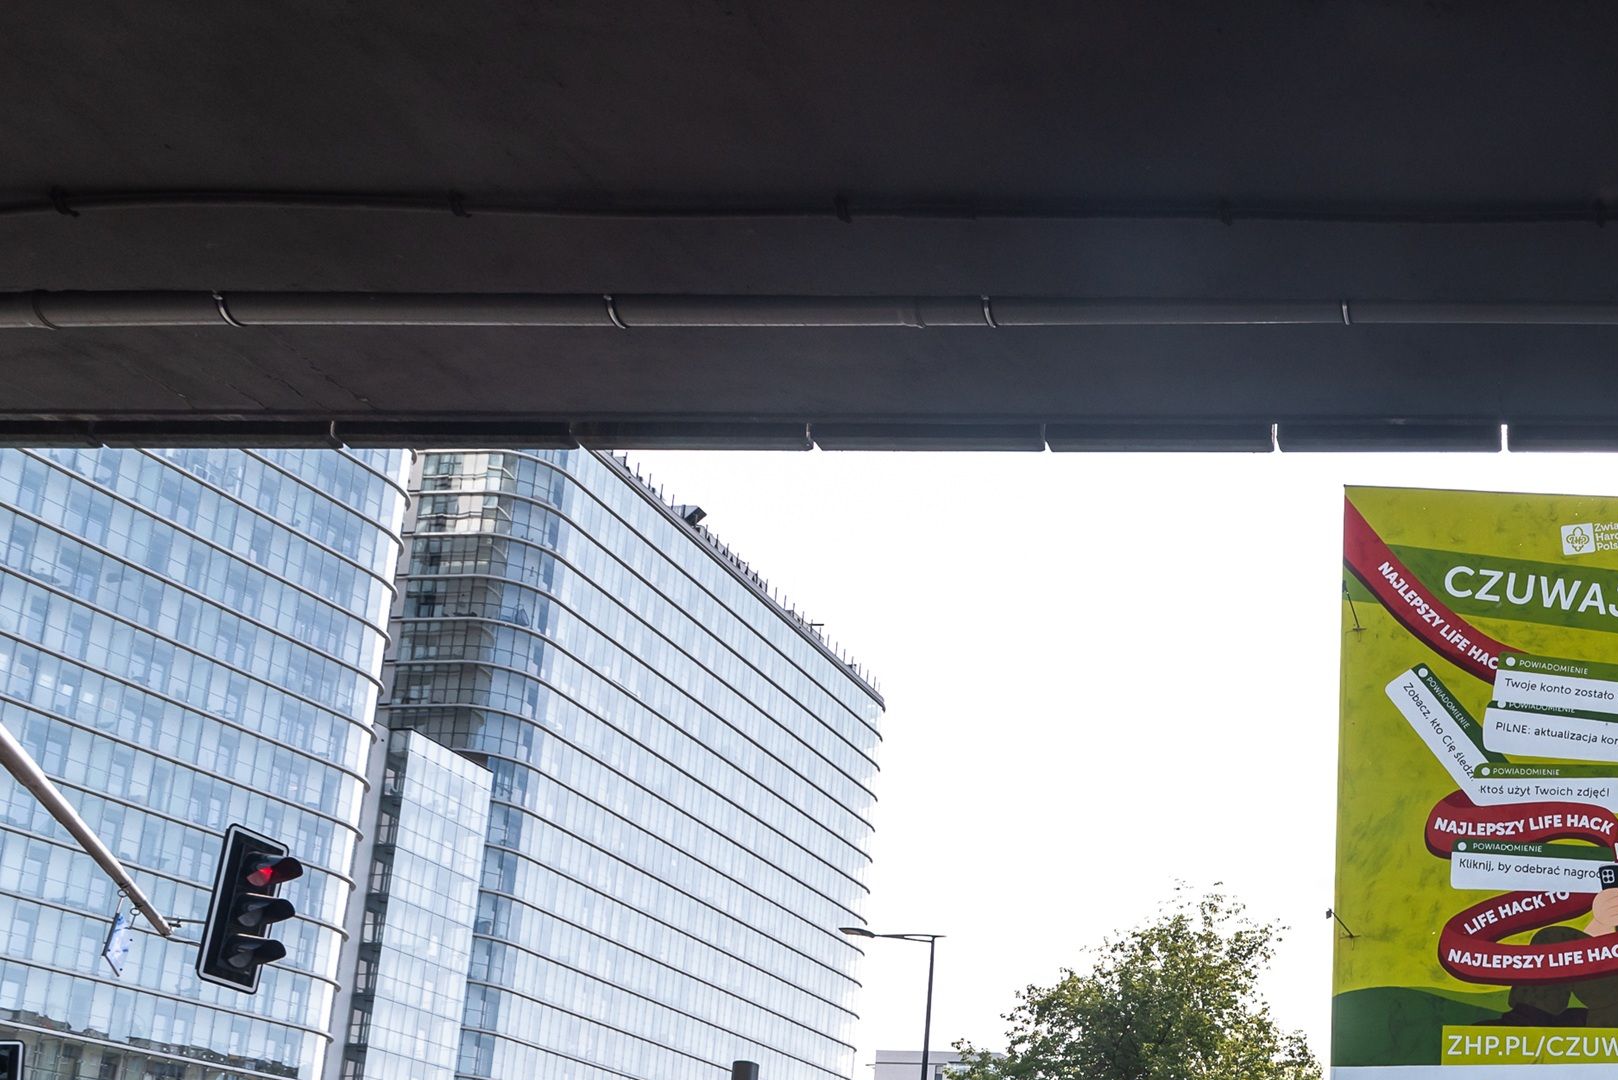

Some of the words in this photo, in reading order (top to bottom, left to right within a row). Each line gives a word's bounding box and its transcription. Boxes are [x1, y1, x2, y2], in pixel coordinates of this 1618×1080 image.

[1378, 561, 1445, 629] NAJLEPSZY
[1439, 624, 1472, 652] LIFE
[1519, 659, 1589, 675] POWIADOMIENIE
[1505, 677, 1538, 692] Twoje
[1540, 680, 1573, 695] konto
[1575, 686, 1615, 701] zostało
[1425, 676, 1472, 730] POWIADOMIENIE
[1403, 682, 1430, 721] Zobacz,
[1429, 717, 1444, 735] kto
[1441, 735, 1457, 753] Cię
[1495, 721, 1531, 735] PILNE:
[1534, 727, 1598, 744] aktualizacja
[1492, 767, 1560, 777] POWIADOMIENIE
[1479, 784, 1505, 795] Ktoś
[1507, 785, 1531, 798] użył
[1534, 785, 1574, 797] Twoich
[1434, 816, 1525, 836] NAJLEPSZY
[1528, 814, 1563, 831] LIFE
[1566, 813, 1614, 836] HACK
[1472, 842, 1543, 853] POWIADOMIENIE
[1458, 858, 1495, 872] Kliknij,
[1497, 862, 1513, 874] by
[1514, 863, 1561, 876] odebrać
[1463, 910, 1498, 936] LIFE
[1498, 896, 1545, 919] HACK
[1447, 948, 1545, 969] NAJLEPSZY
[1548, 950, 1584, 967] LIFE
